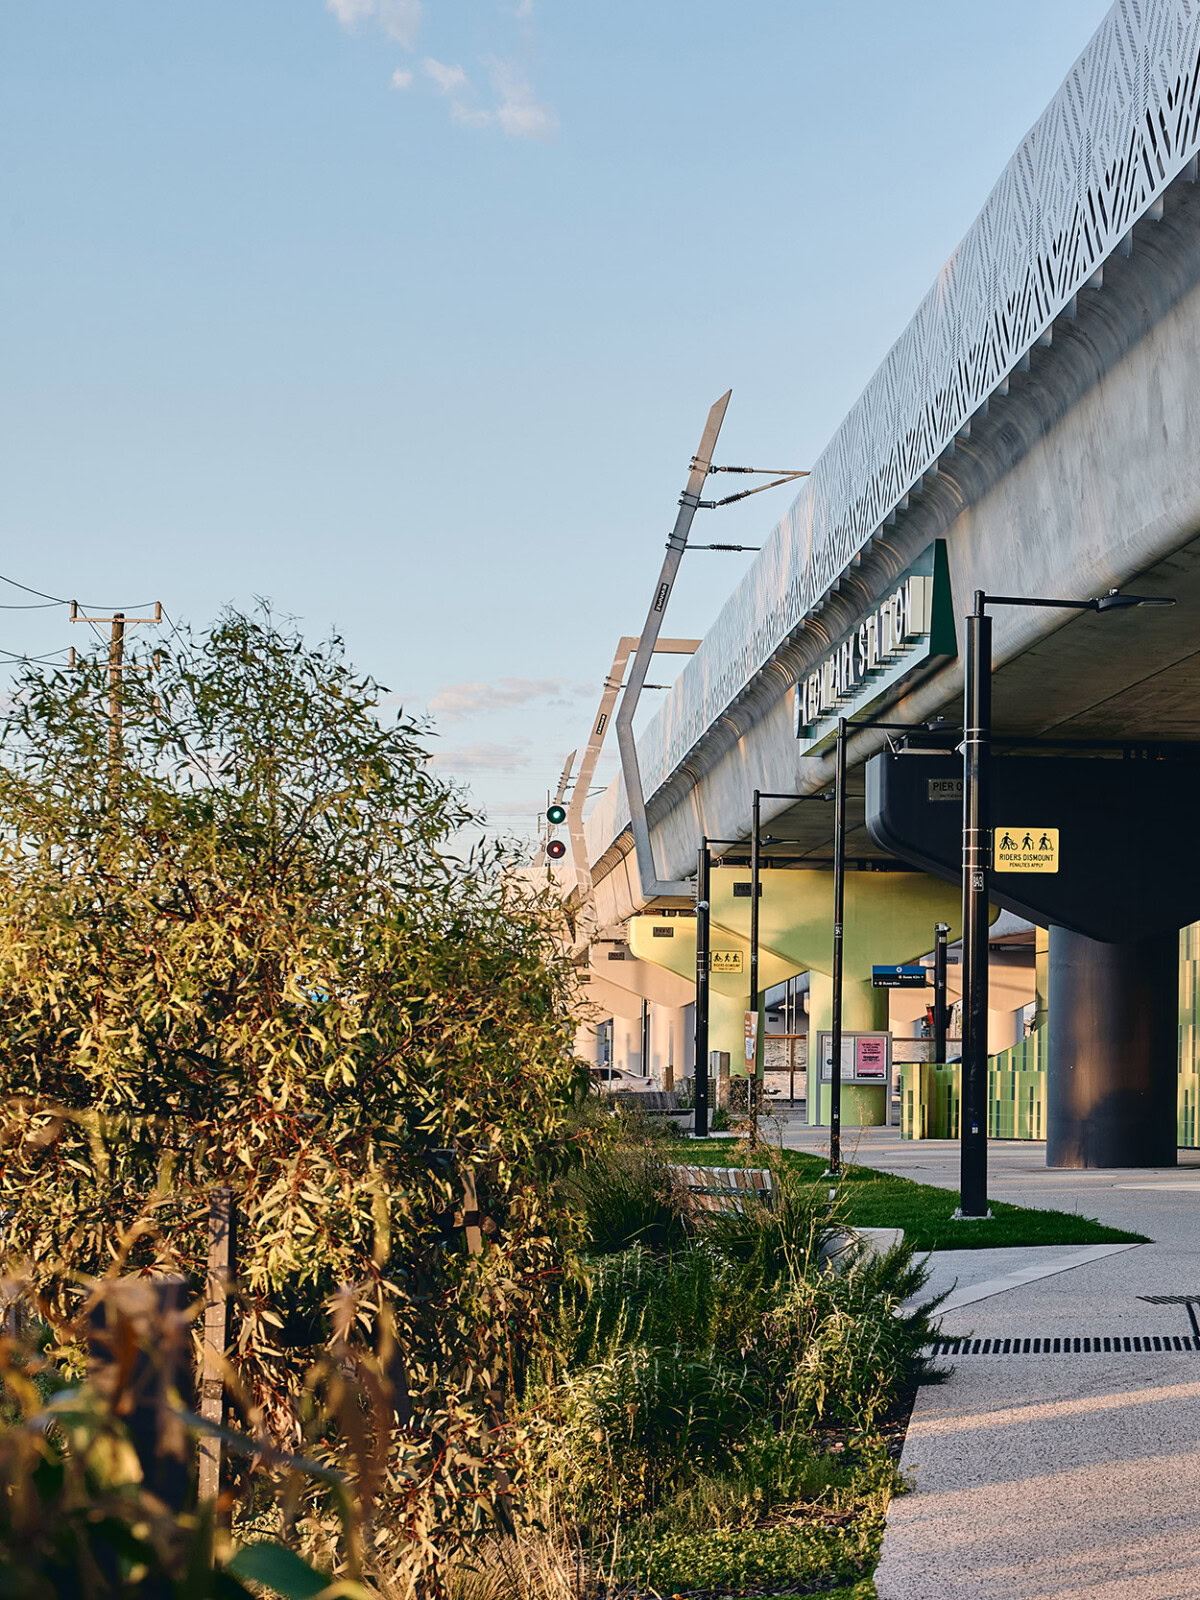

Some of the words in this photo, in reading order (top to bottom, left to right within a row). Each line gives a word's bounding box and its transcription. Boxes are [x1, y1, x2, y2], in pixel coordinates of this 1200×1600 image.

[858, 576, 933, 678] STATION
[933, 782, 954, 791] PIER
[999, 853, 1022, 861] RIDERS
[1023, 853, 1054, 862] DISMOUNT
